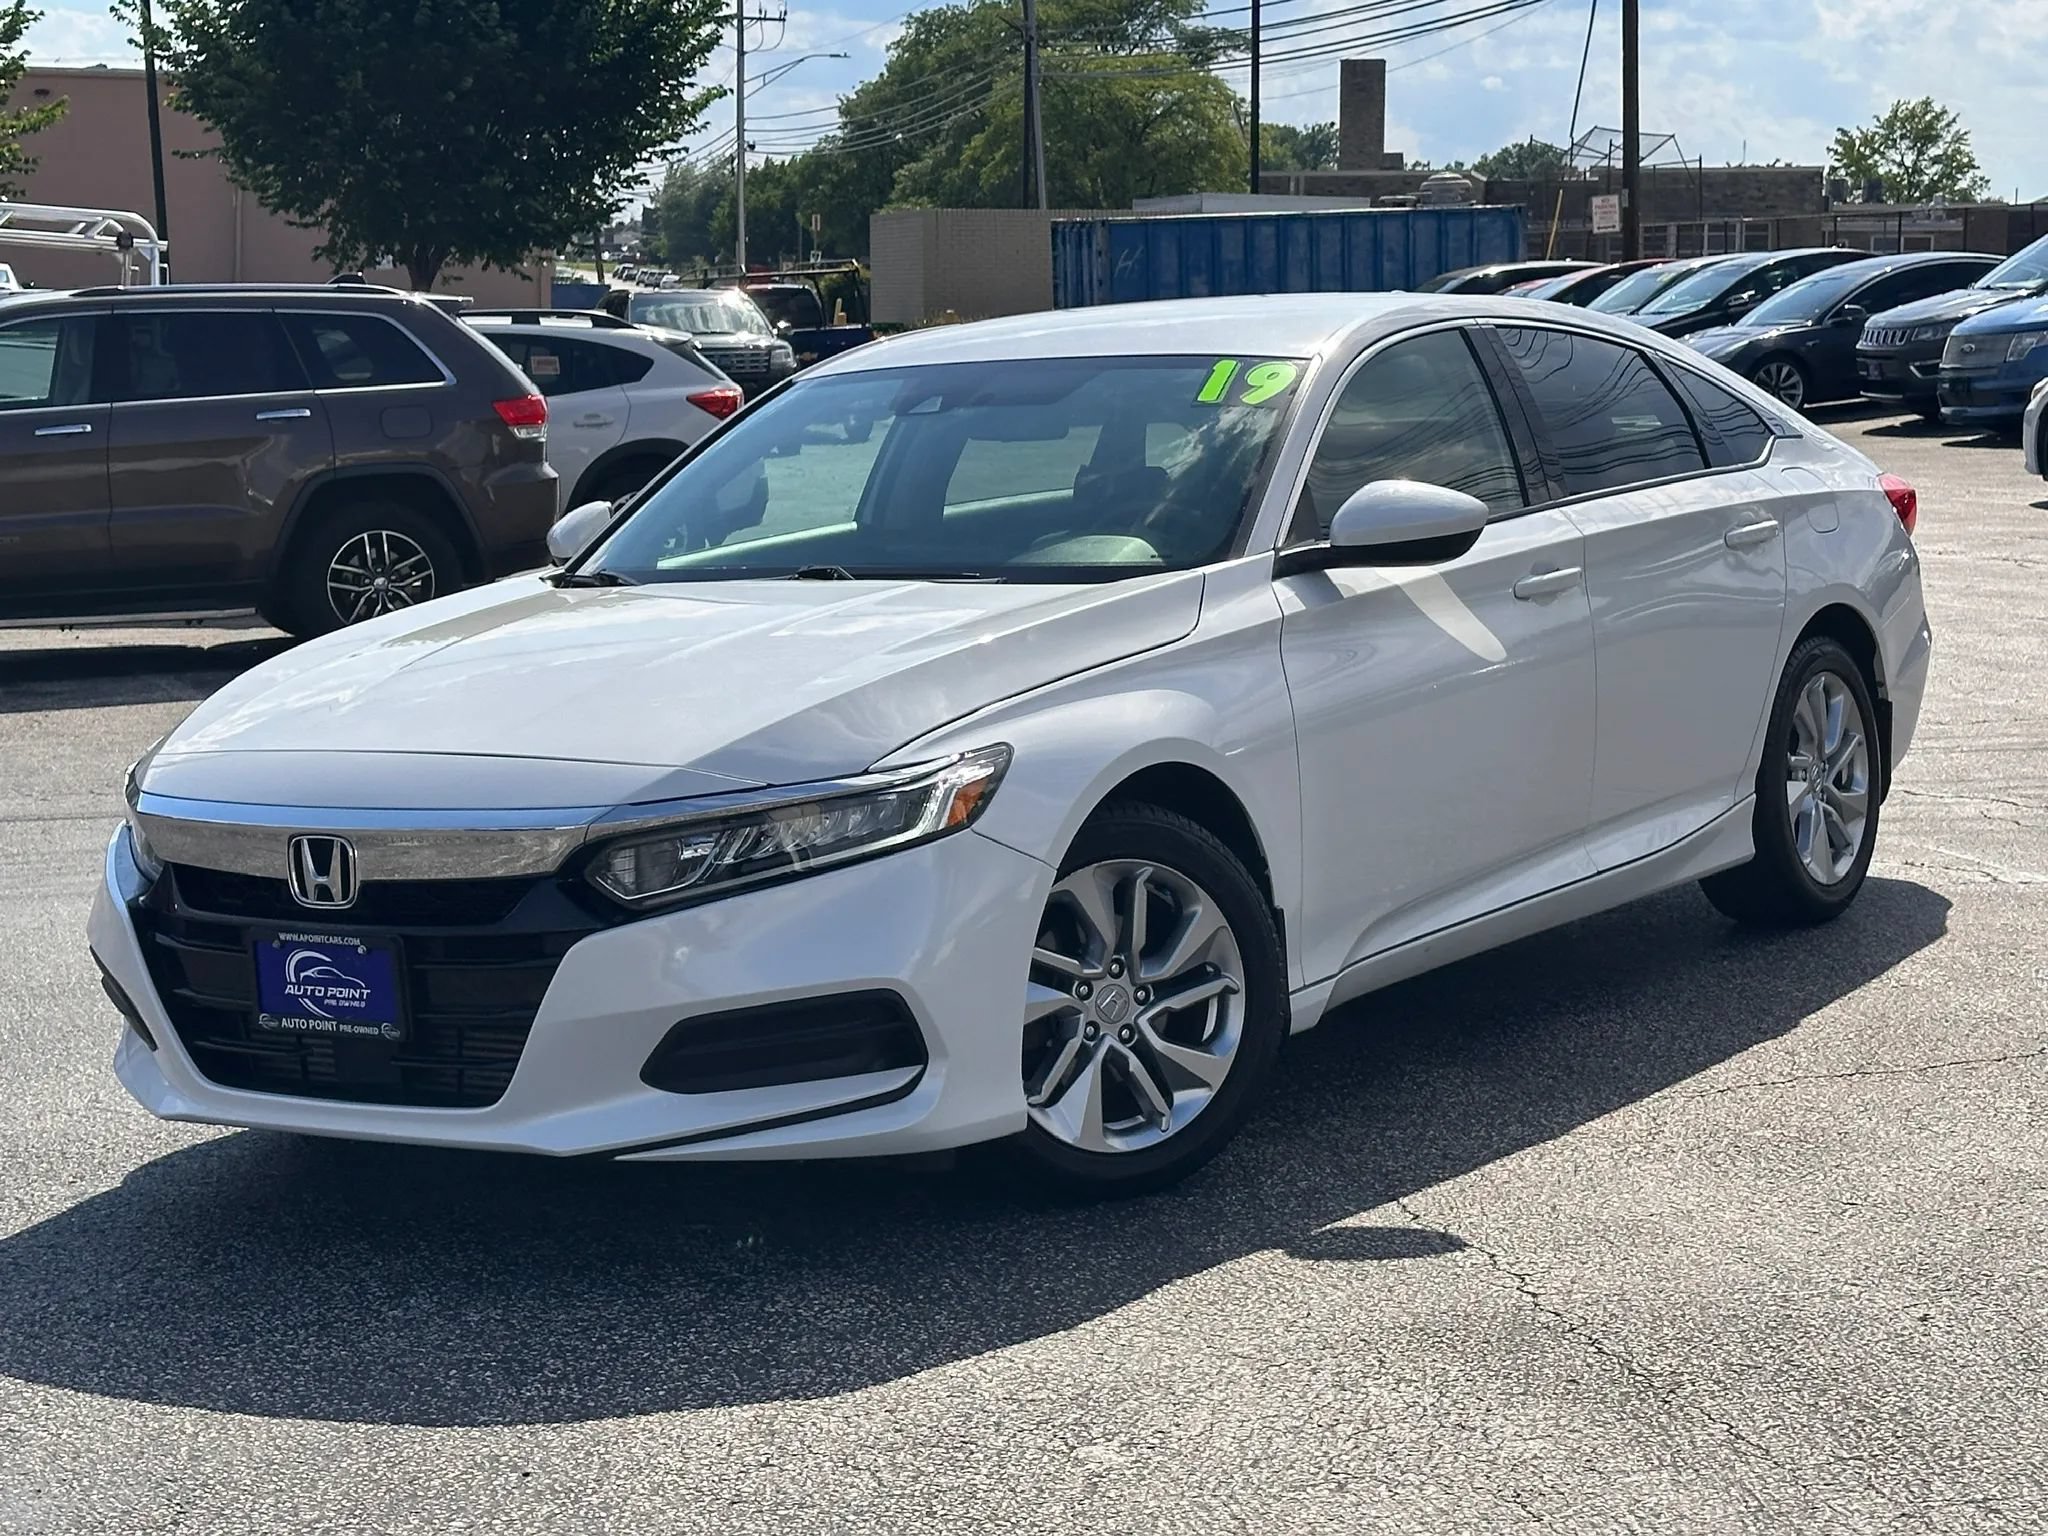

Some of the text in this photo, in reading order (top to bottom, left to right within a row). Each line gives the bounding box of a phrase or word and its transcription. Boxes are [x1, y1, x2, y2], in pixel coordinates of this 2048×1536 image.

[1196, 359, 1299, 405] 19
[278, 932, 361, 946] WWW.APOINTCARS.COM
[284, 984, 371, 1000] AUTO POINT
[281, 1018, 379, 1035] AUTO POINT PRE-OWNED
